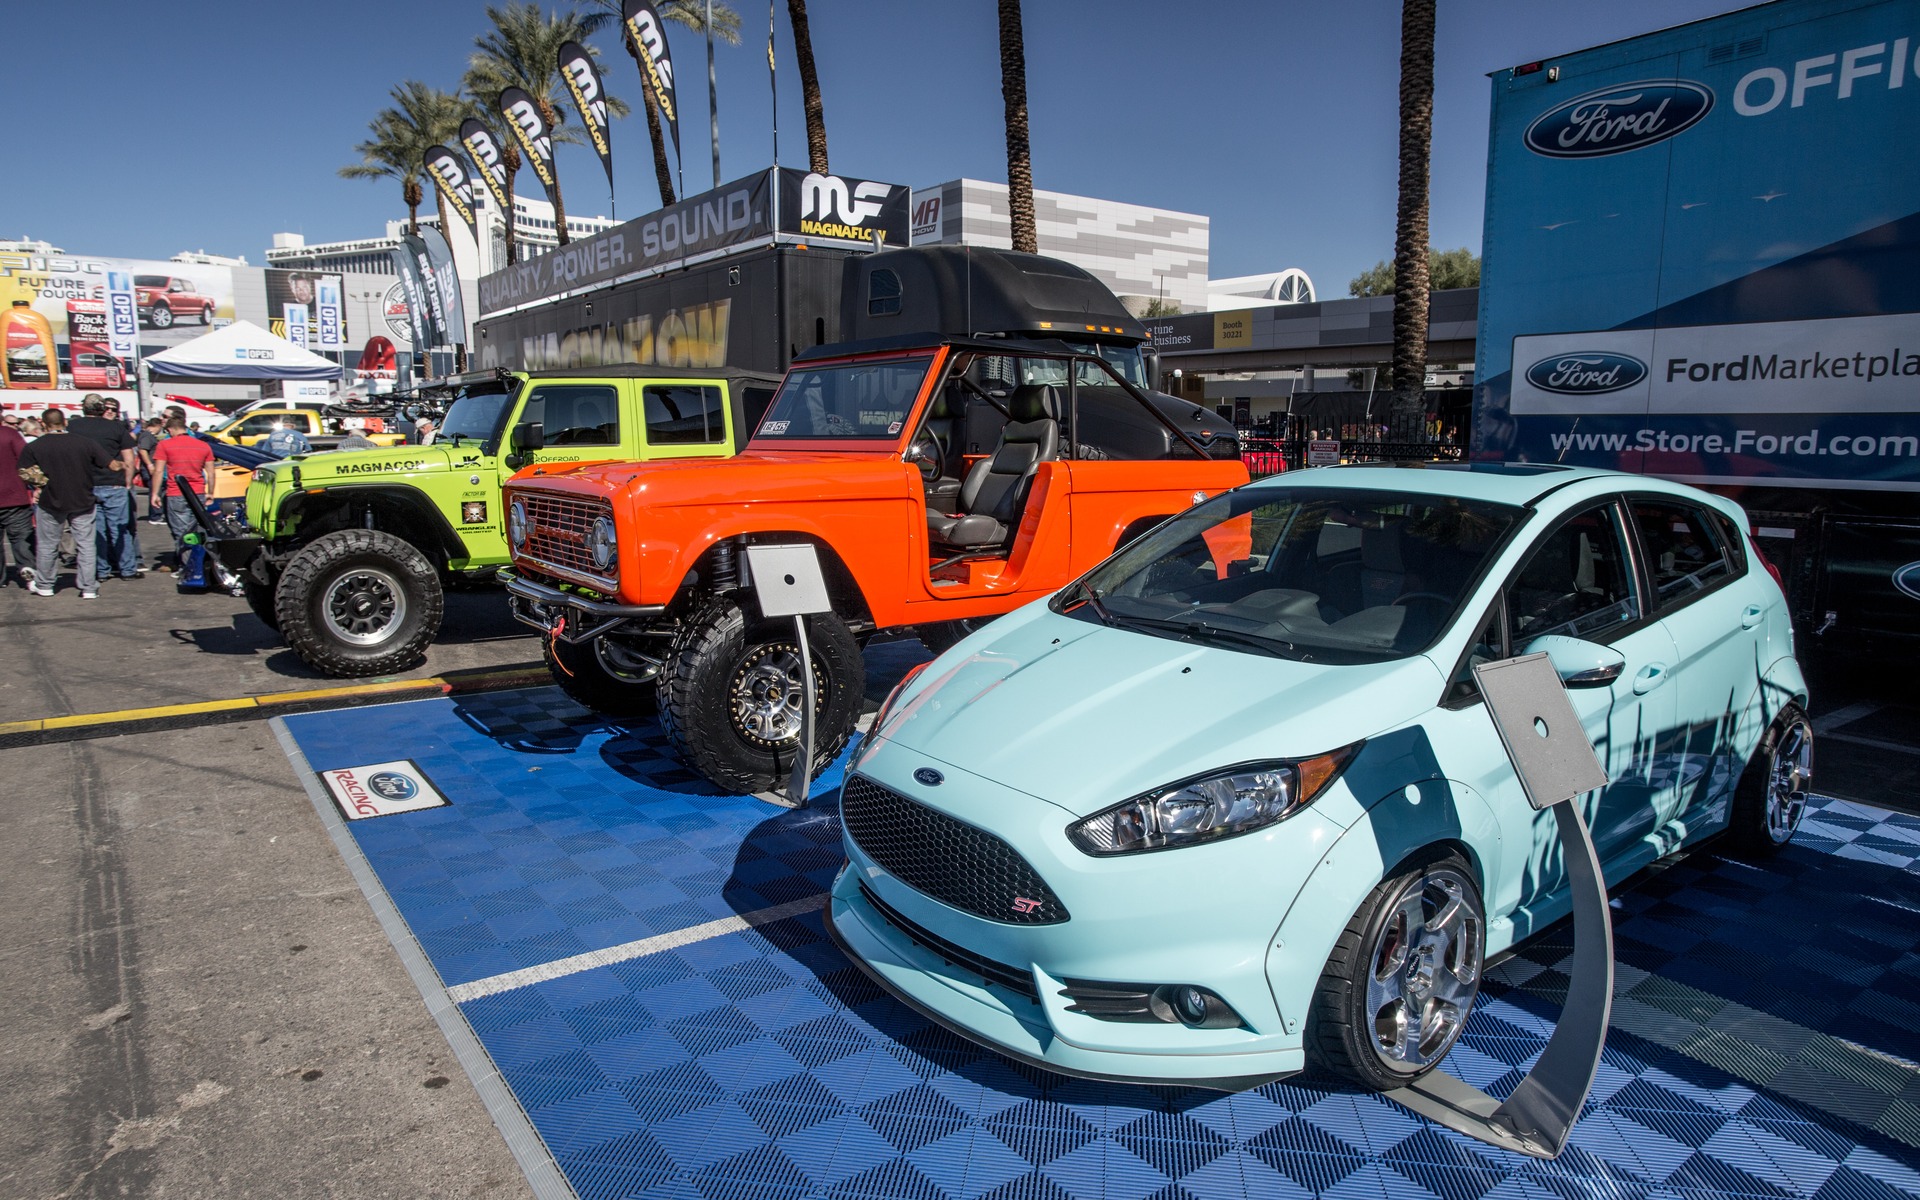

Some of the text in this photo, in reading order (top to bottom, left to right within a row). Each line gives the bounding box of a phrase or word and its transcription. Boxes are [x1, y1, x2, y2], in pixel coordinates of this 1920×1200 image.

[626, 17, 676, 121] MAGNAFLOW
[1733, 37, 1920, 117] OFFI
[561, 65, 609, 155] MAGNAFLOW
[503, 108, 554, 186] MAGNAFLOW
[463, 138, 509, 208] MAGNAFLOW
[427, 163, 475, 225] MAGNAFLOW
[553, 233, 633, 285] POWER.
[642, 189, 761, 258] SOUND.
[18, 277, 86, 290] FUTURE
[32, 288, 87, 300] TOUGH
[112, 295, 133, 333] OPEN
[322, 308, 337, 343] OPEN
[1223, 321, 1242, 329] Booth
[292, 326, 304, 348] OPE
[1154, 325, 1174, 335] tune
[1154, 335, 1192, 346] business
[1223, 331, 1242, 339] 30221
[249, 349, 274, 359] OPEN
[1551, 429, 1918, 457] www.Store.Ford.com
[336, 460, 424, 474] MAGNACON
[332, 769, 380, 816] RACING
[1012, 897, 1042, 913] ST
